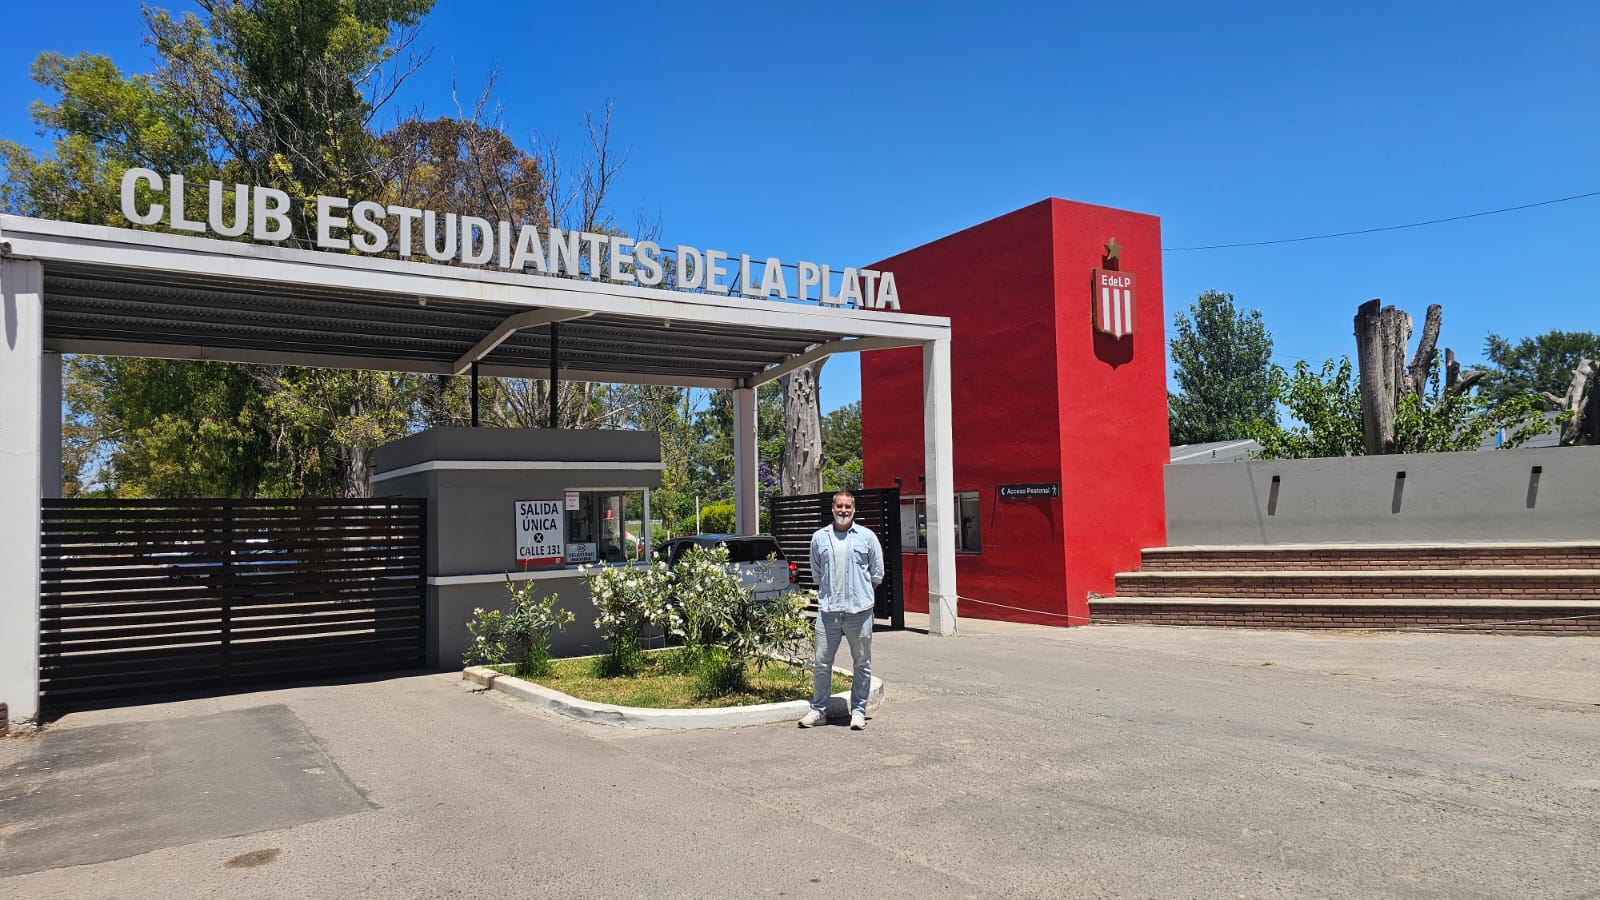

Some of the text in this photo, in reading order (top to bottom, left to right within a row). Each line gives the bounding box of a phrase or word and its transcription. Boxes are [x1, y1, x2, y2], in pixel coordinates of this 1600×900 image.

[120, 167, 901, 311] CLUB ESTUDIANTES DE LA PLATA
[521, 503, 559, 515] SALIDA
[522, 516, 557, 531] ÚNICA
[519, 544, 561, 556] CALLE 131
